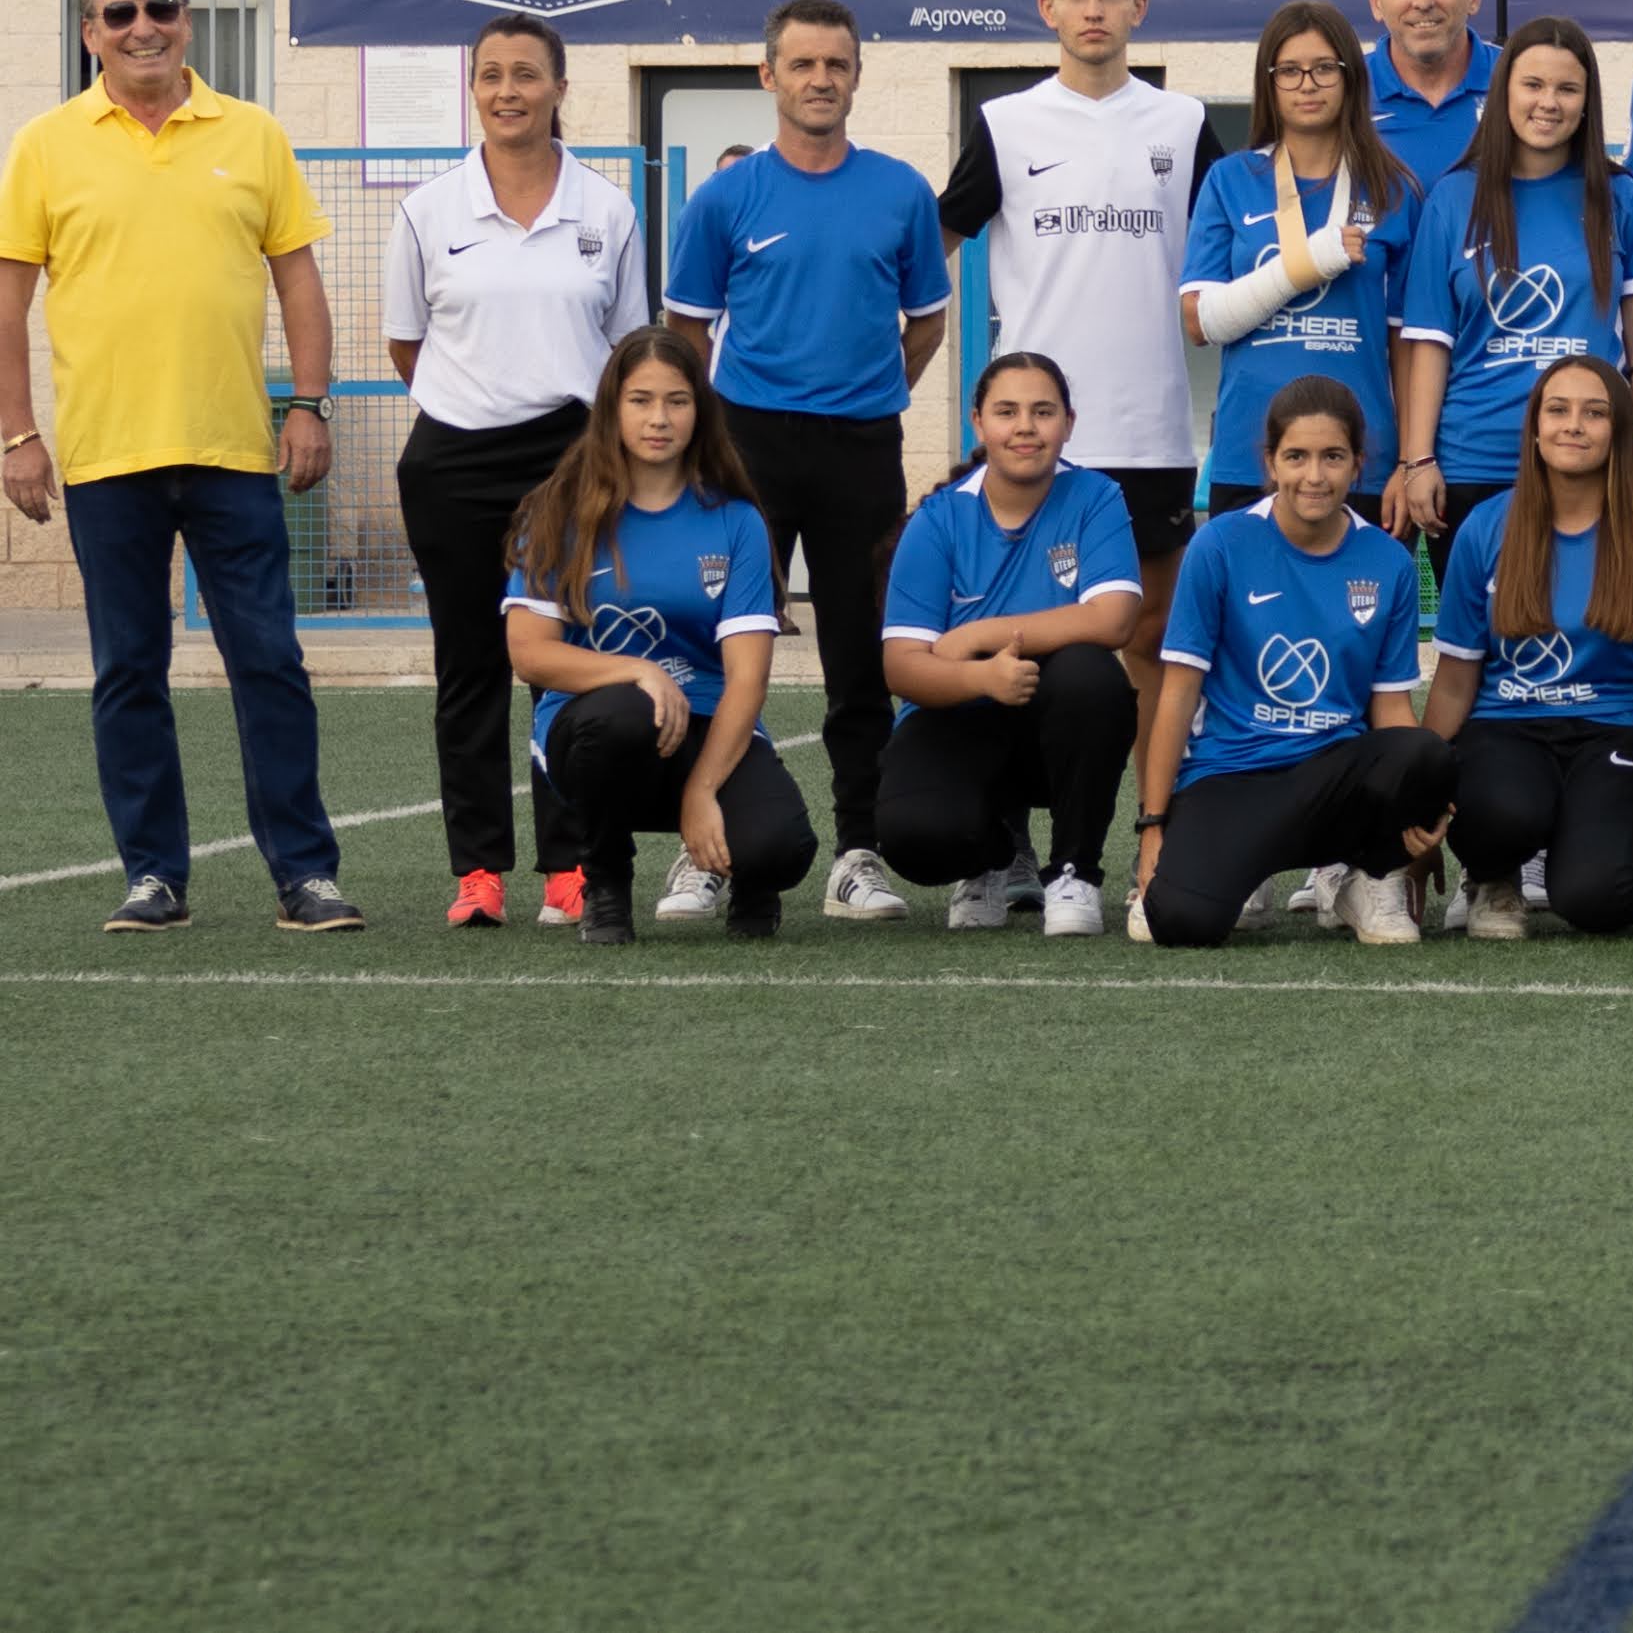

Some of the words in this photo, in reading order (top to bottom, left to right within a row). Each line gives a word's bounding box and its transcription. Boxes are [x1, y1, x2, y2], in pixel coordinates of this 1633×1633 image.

[917, 7, 1007, 32] Agroveco
[1304, 341, 1356, 353] ESPAÑA
[1486, 336, 1589, 357] SPHERE
[1052, 557, 1078, 574] UTEBO
[1350, 595, 1377, 608] UTEBO
